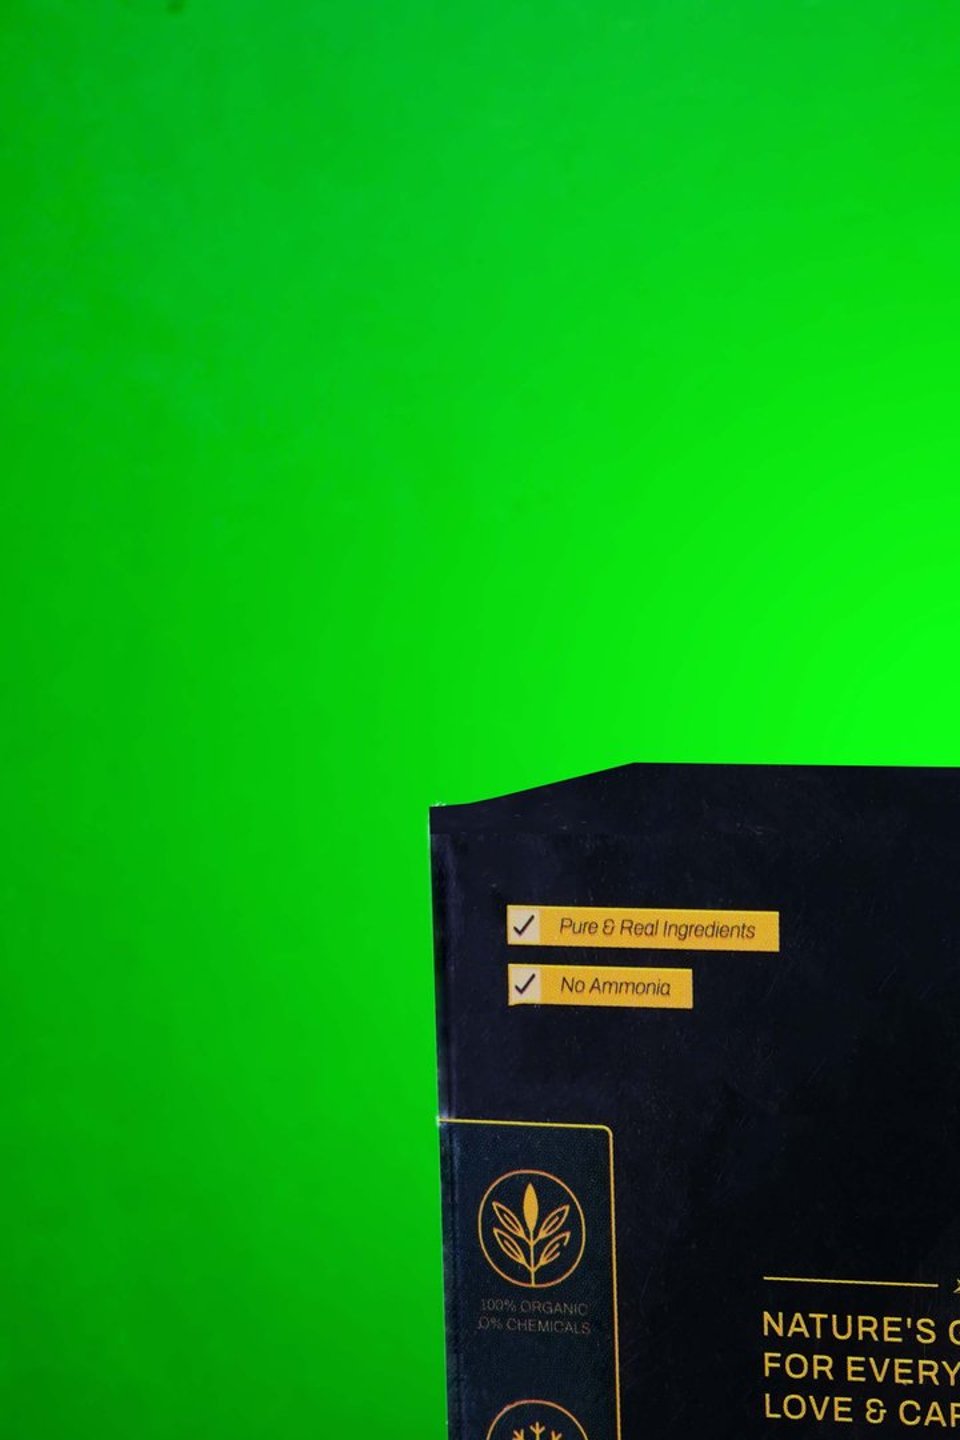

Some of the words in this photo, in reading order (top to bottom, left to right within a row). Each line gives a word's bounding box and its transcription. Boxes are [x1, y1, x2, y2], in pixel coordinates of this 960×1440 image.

[559, 917, 598, 935] Pure
[602, 919, 615, 936] &
[620, 918, 659, 937] Real
[663, 920, 756, 941] Ingredients
[560, 976, 585, 993] No
[589, 977, 672, 997] Ammonia
[480, 1298, 516, 1312] 100%
[520, 1299, 589, 1316] ORGANIC
[506, 1317, 591, 1335] CHEMICALS
[762, 1310, 937, 1345] NATURE'S
[764, 1353, 834, 1380] FOR
[764, 1393, 853, 1422] LOVE
[865, 1398, 888, 1424] &
